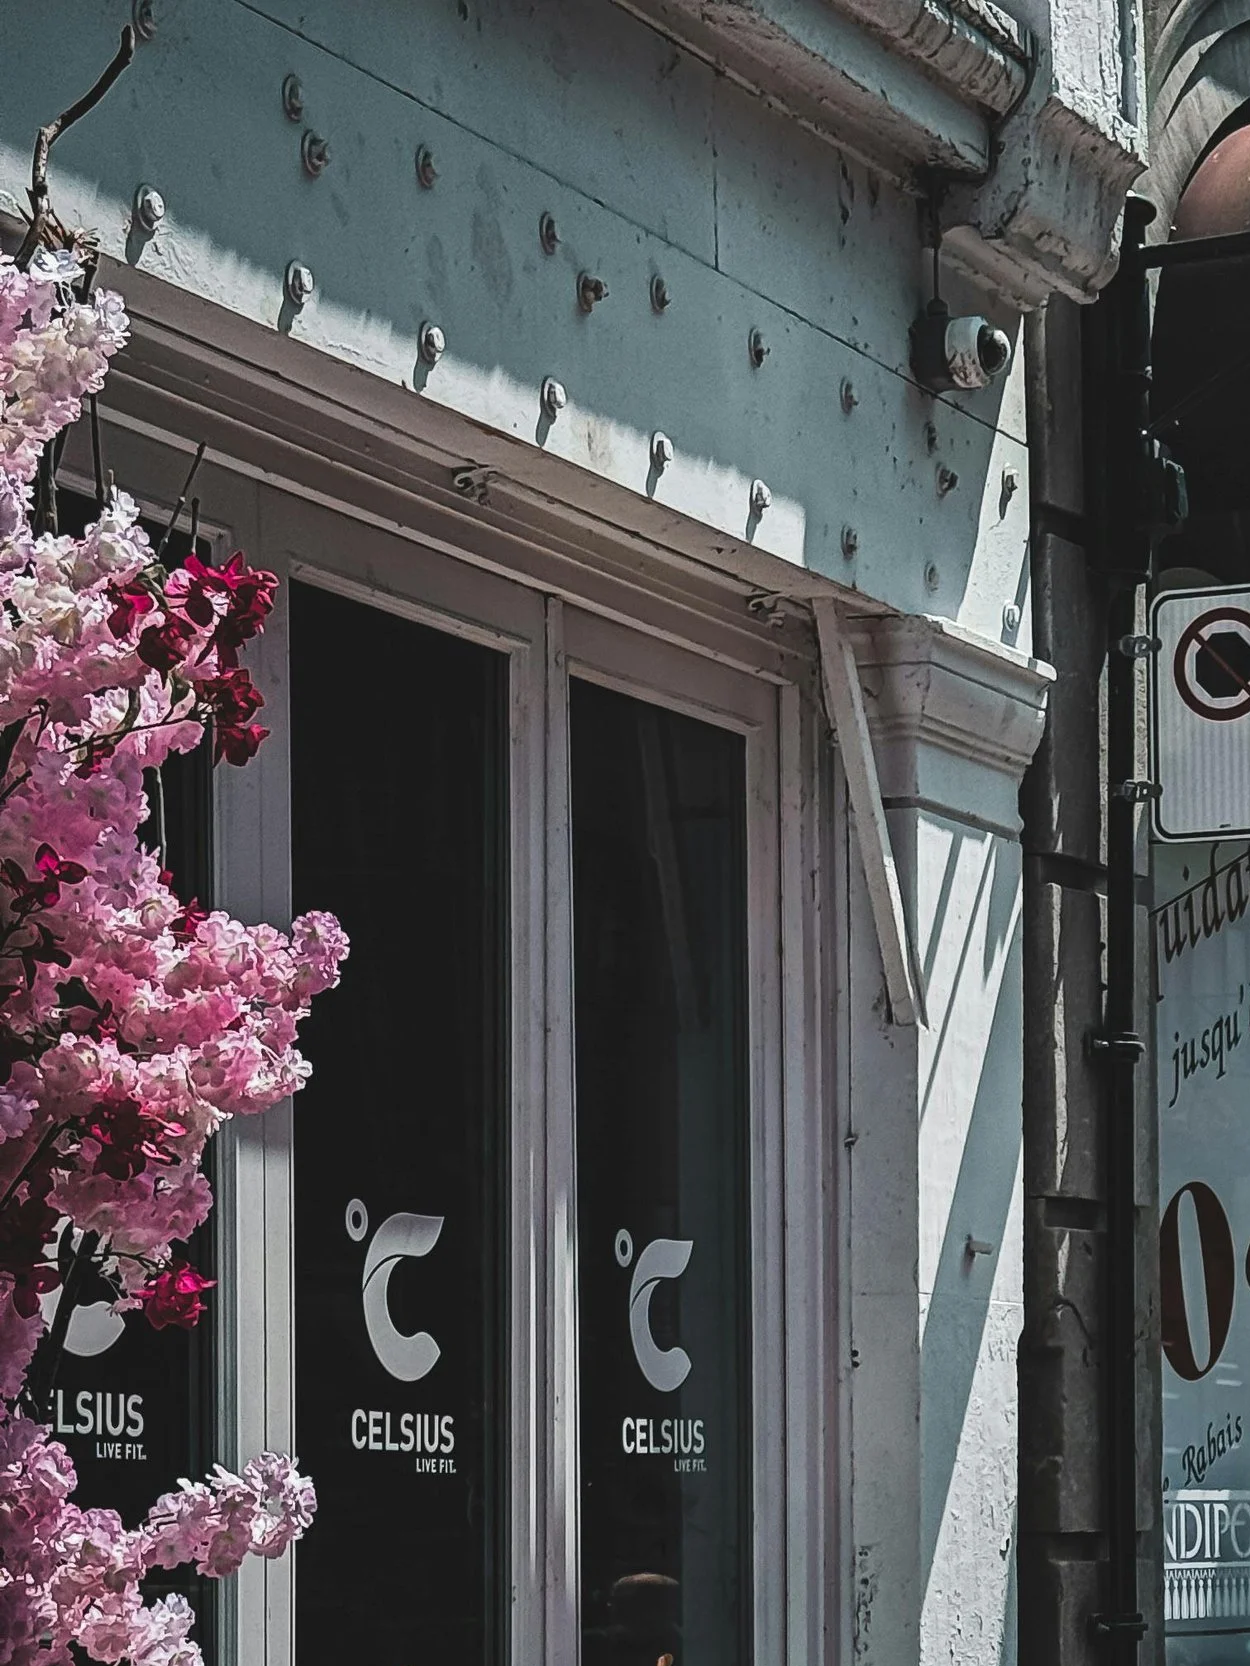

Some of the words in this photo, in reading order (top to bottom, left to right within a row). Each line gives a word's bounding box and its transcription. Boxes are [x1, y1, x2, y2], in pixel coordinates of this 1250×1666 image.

[50, 1388, 145, 1438] LSIUS
[351, 1408, 455, 1454] CELSIUS
[96, 1442, 121, 1459] LIVE
[621, 1416, 705, 1455] CELSIUS
[1182, 1413, 1243, 1487] Rabais
[416, 1457, 437, 1473] LIVE
[674, 1458, 690, 1472] LIVE
